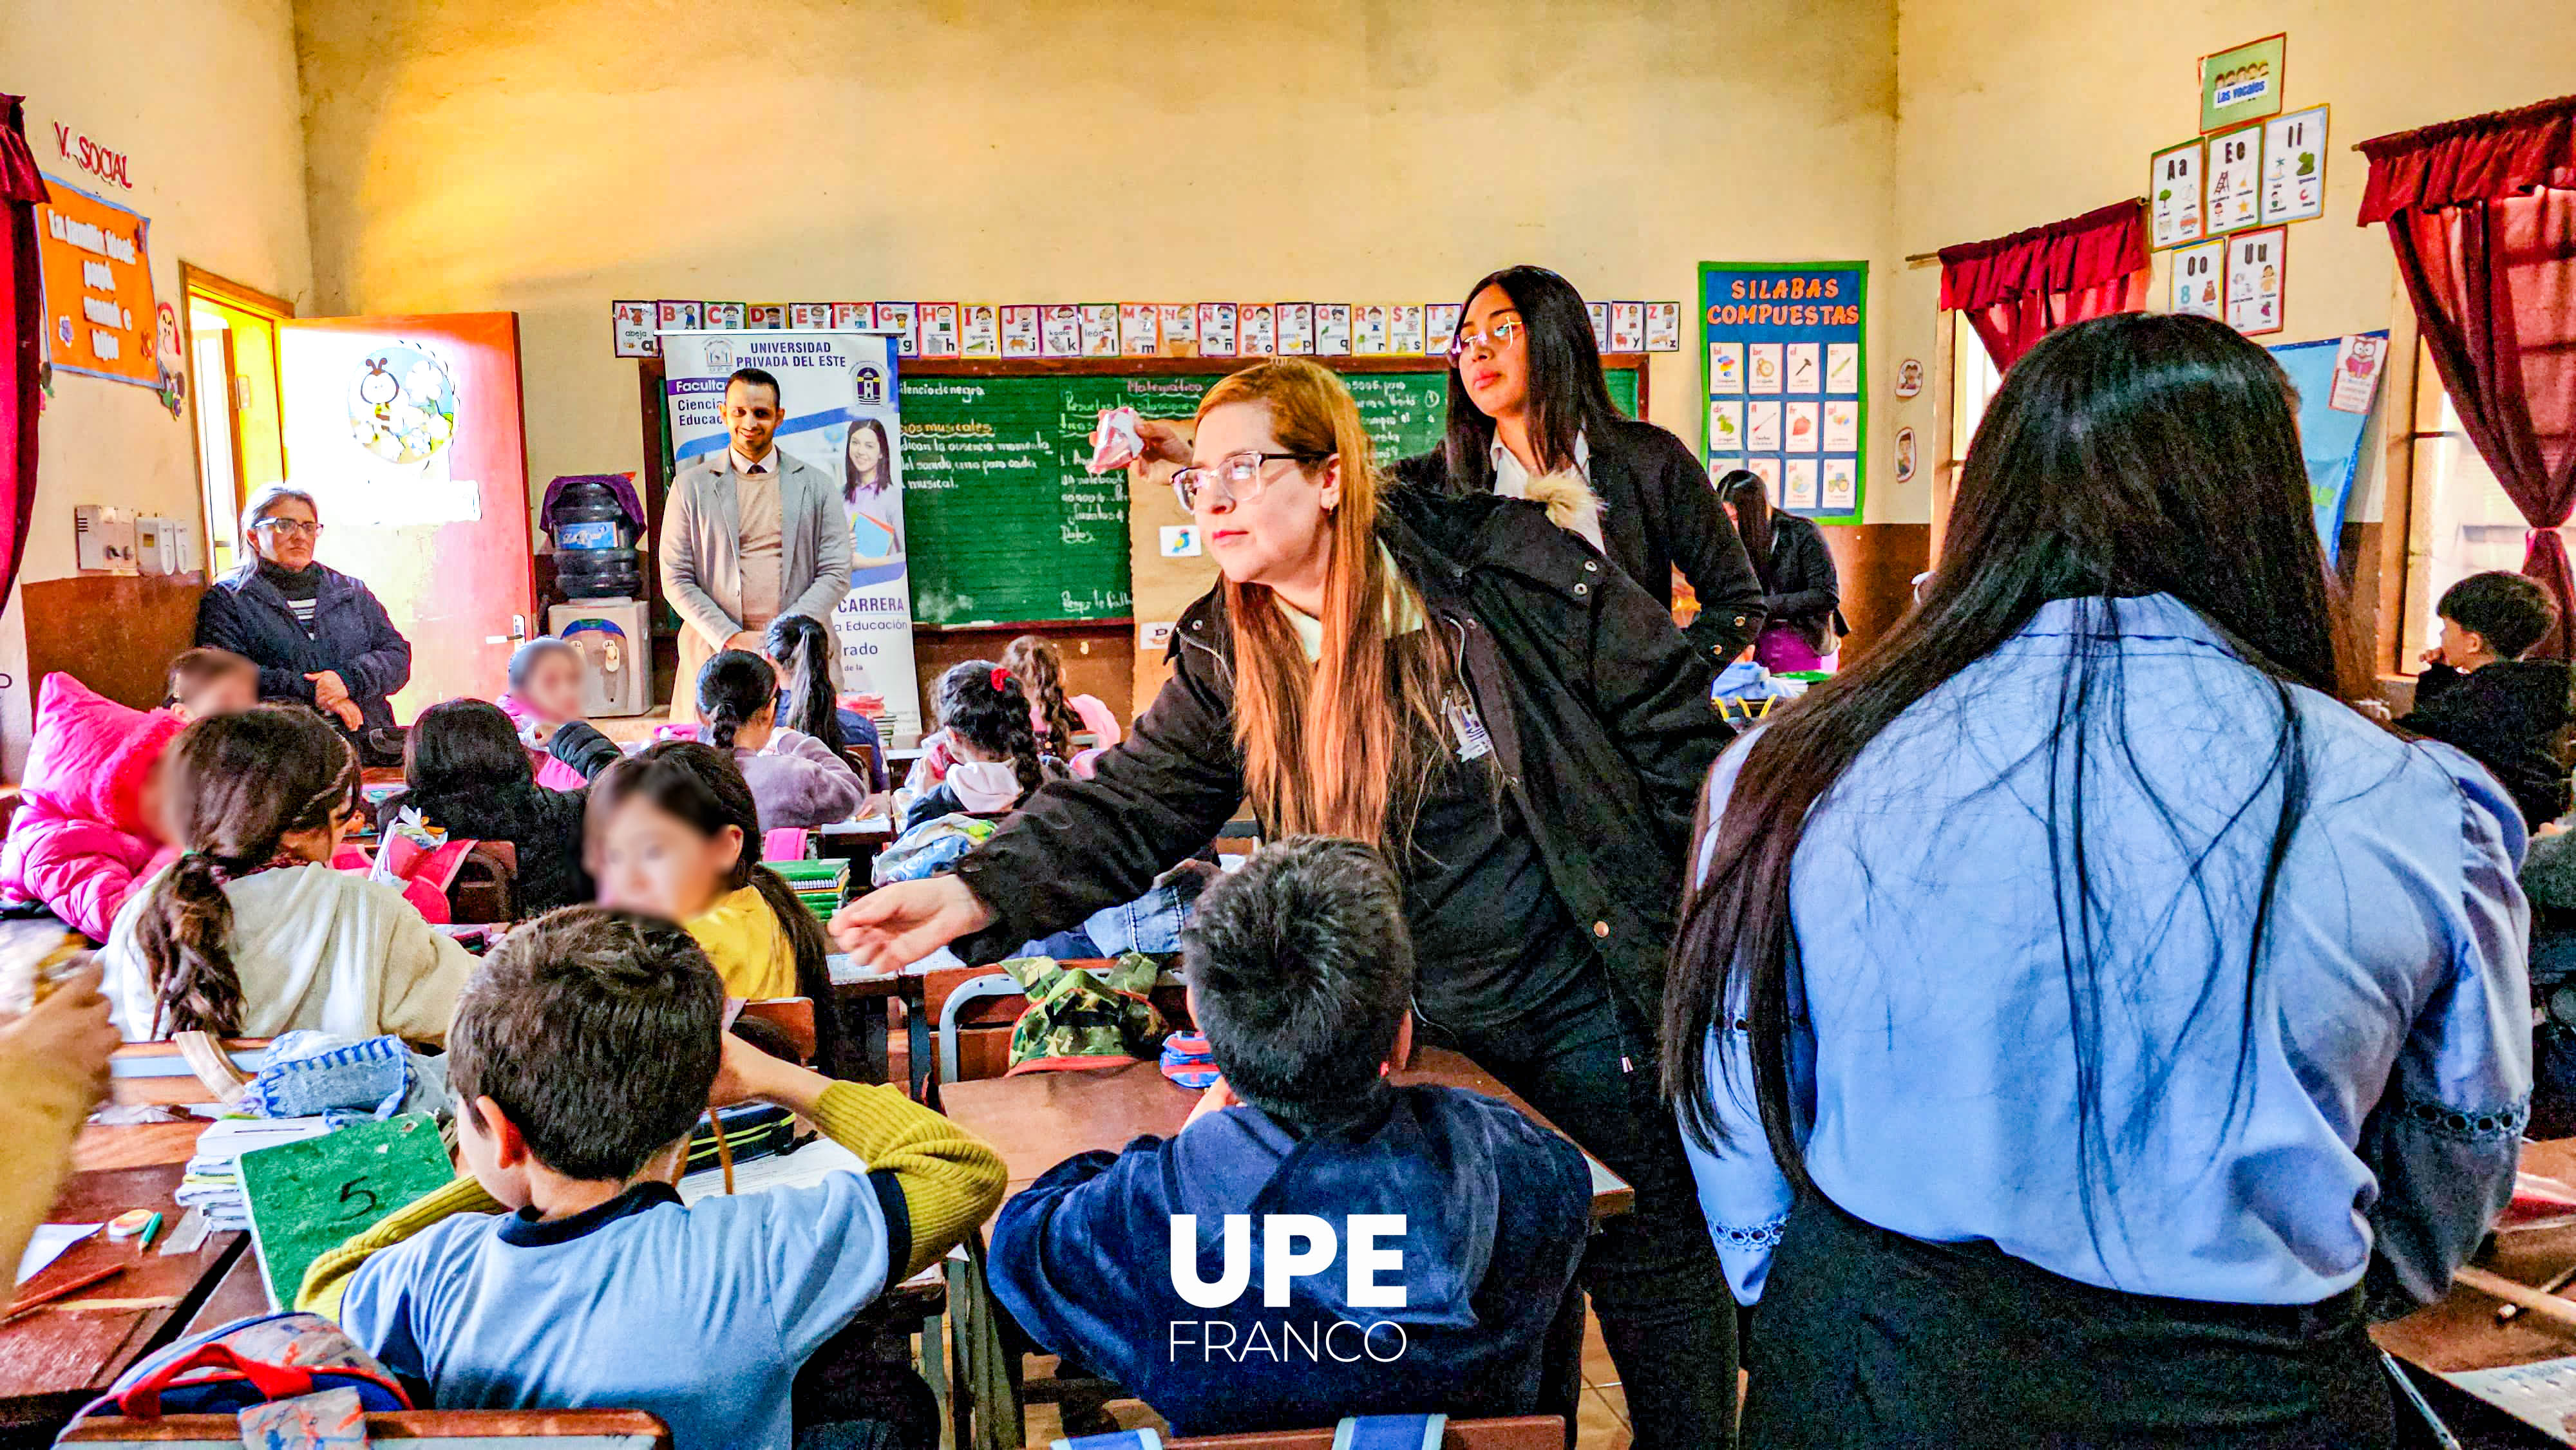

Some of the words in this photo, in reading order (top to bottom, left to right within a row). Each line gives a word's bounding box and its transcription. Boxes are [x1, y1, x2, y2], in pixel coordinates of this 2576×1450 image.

[2217, 90, 2231, 103] Las
[79, 136, 132, 189] SOCIAL
[1731, 278, 1839, 299] SILABAS
[618, 305, 629, 320] A
[663, 306, 676, 321] B
[708, 306, 722, 323] C
[751, 308, 764, 322] D
[796, 309, 808, 323] E
[840, 308, 850, 323] F
[880, 306, 894, 321] G
[922, 308, 936, 322] H
[1006, 308, 1015, 325] J
[1045, 308, 1057, 322] K
[1084, 308, 1094, 323] L
[1124, 308, 1134, 319] M
[1243, 309, 1254, 321] O
[1319, 307, 1329, 321] Q
[1355, 307, 1366, 321] R
[1393, 306, 1402, 320] S
[1428, 307, 1439, 320] T
[1615, 306, 1623, 319] Y
[1649, 306, 1657, 319] Z
[1707, 303, 1860, 325] COMPUESTAS
[625, 330, 647, 339] abeja
[1084, 329, 1104, 337] león
[641, 341, 654, 352] a
[751, 342, 831, 354] UNIVERSIDAD
[903, 340, 913, 352] g
[946, 338, 954, 352] h
[1030, 337, 1036, 352] j
[1068, 337, 1076, 351] k
[1142, 344, 1155, 353] m
[1225, 338, 1233, 351] ñ
[1303, 340, 1311, 352] p
[1340, 339, 1349, 351] q
[1378, 342, 1385, 351] r
[1414, 341, 1421, 350] s
[1633, 337, 1640, 348] y
[736, 356, 789, 368] PRIVADA
[793, 356, 815, 367] DEL
[819, 355, 846, 367] ESTE
[676, 379, 726, 392] Faculta
[900, 381, 934, 395] ilencio
[679, 413, 723, 426] Educac
[838, 598, 904, 613] CARRERA
[846, 619, 907, 631] Educación
[843, 641, 878, 656] rado
[339, 1176, 377, 1221] 5
